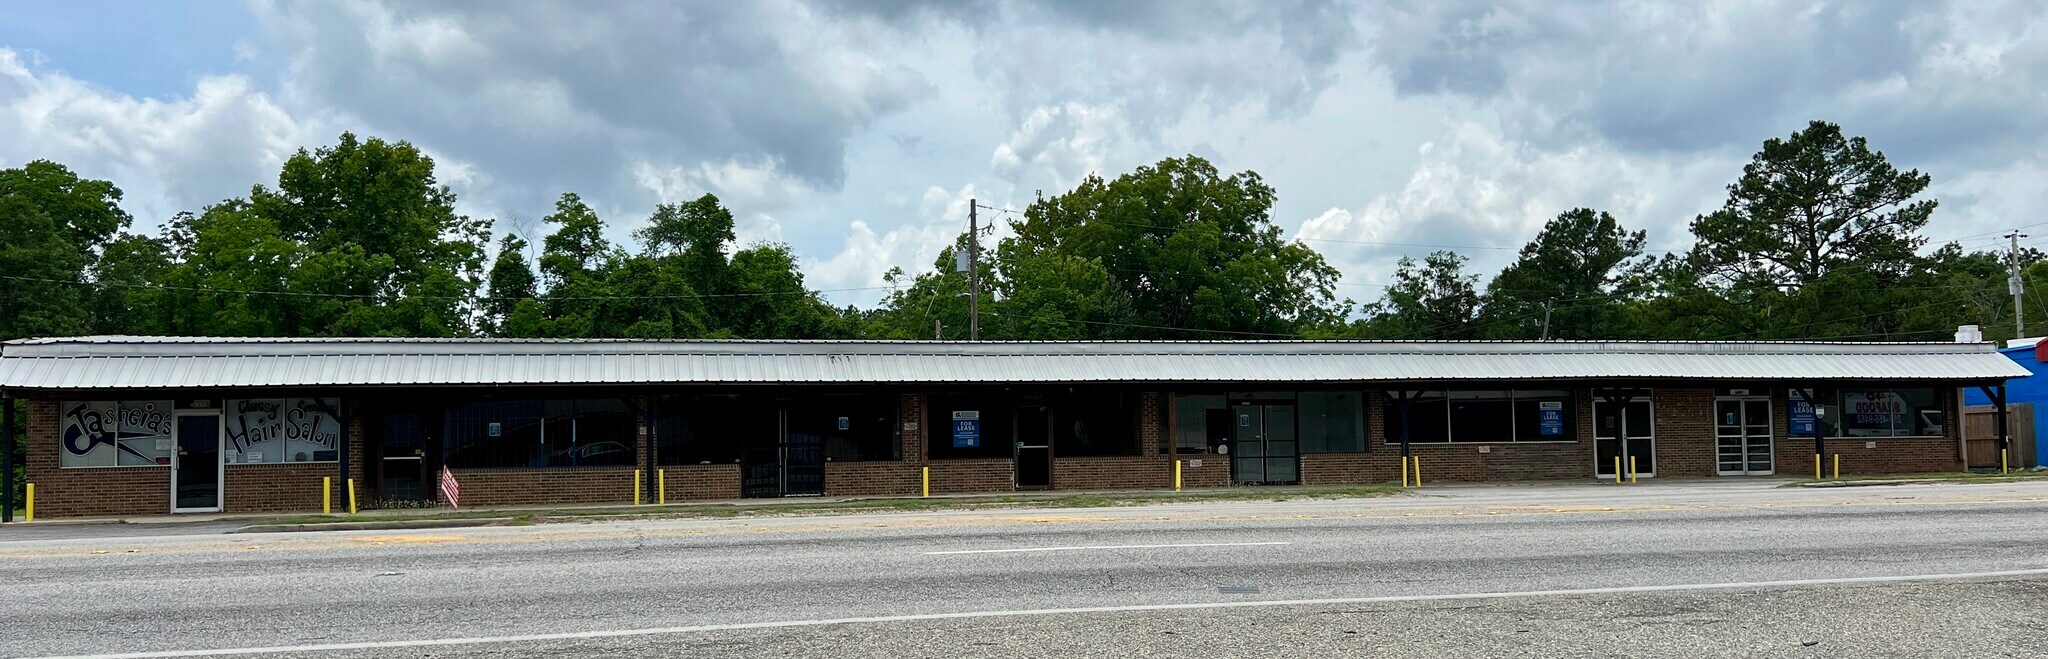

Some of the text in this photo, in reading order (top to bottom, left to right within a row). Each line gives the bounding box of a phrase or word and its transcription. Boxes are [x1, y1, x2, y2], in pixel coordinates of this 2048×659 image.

[66, 402, 171, 436] Tasheia's
[226, 407, 336, 455] Hair Salon
